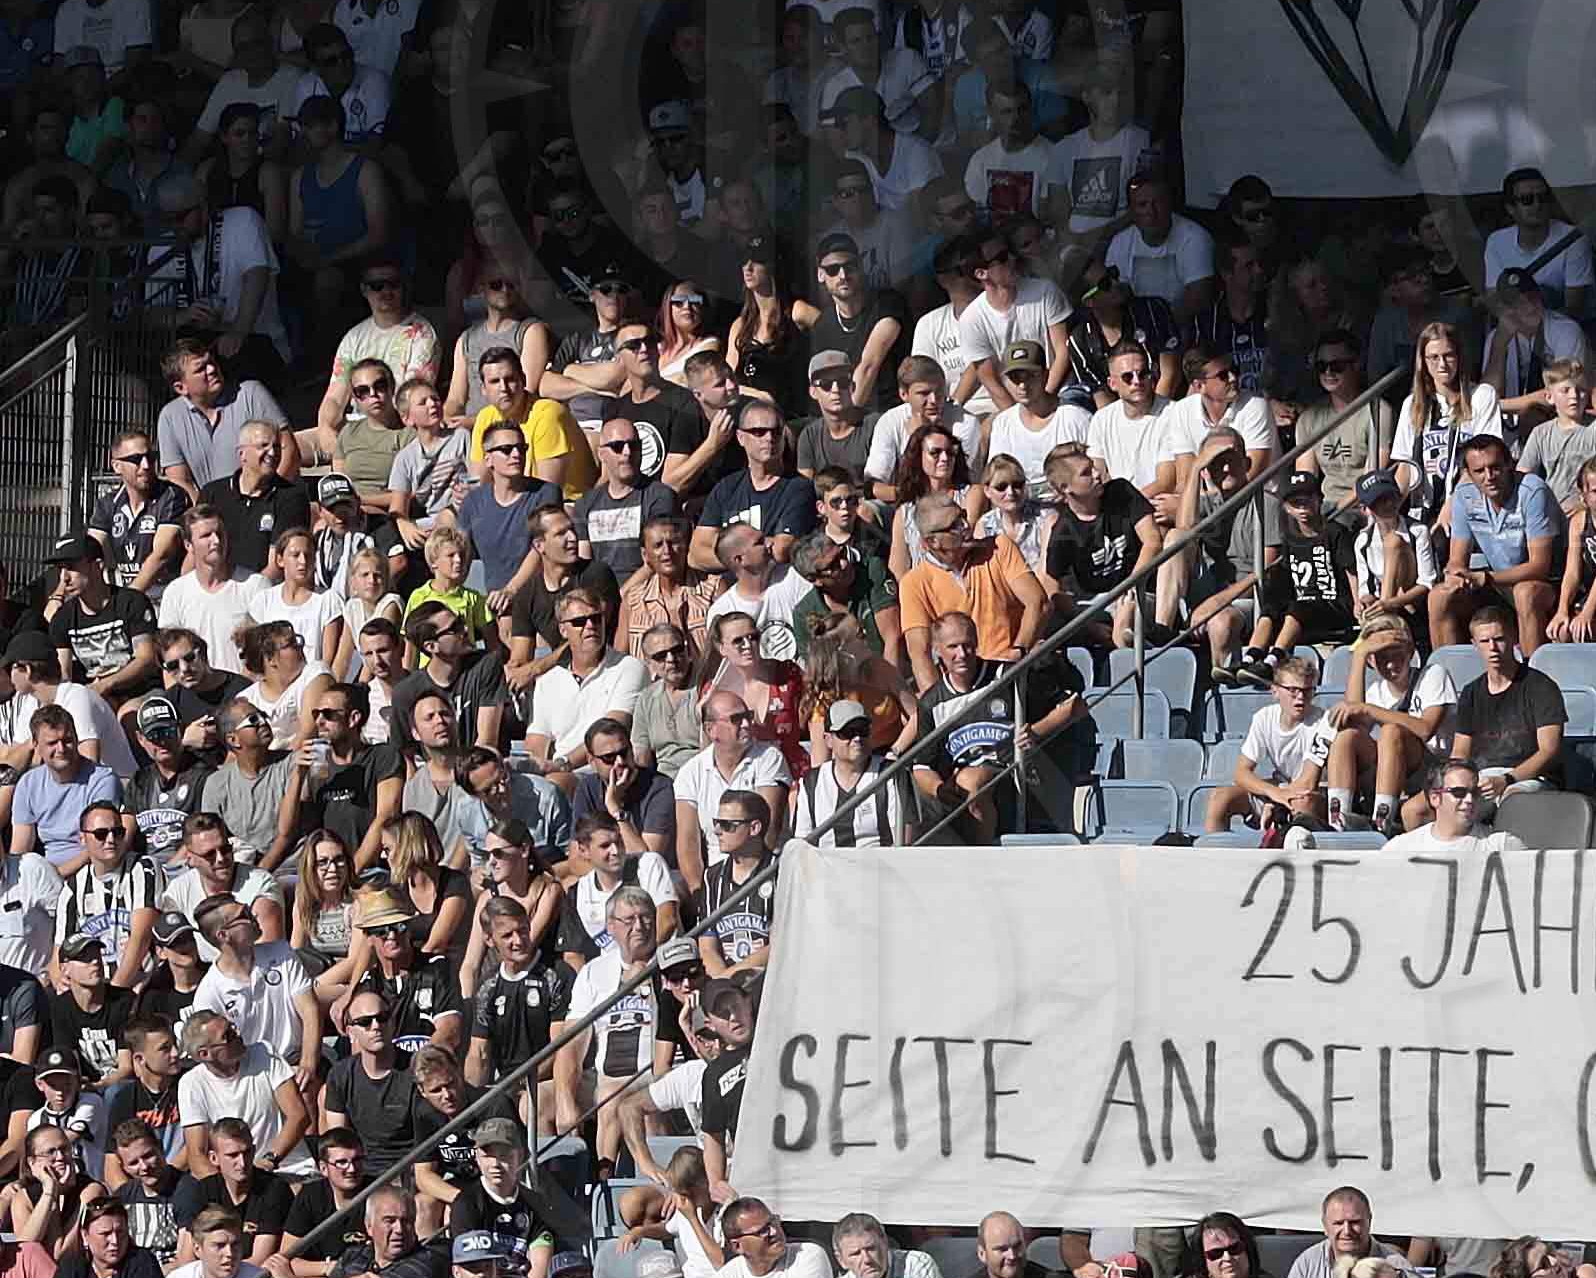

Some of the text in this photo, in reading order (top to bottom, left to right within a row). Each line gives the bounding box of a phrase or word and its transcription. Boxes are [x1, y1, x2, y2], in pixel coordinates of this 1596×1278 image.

[1239, 858, 1362, 986] 25
[771, 1033, 1036, 1165] SEITE
[1082, 1037, 1218, 1168] AN
[1262, 1035, 1536, 1193] SEITE,
